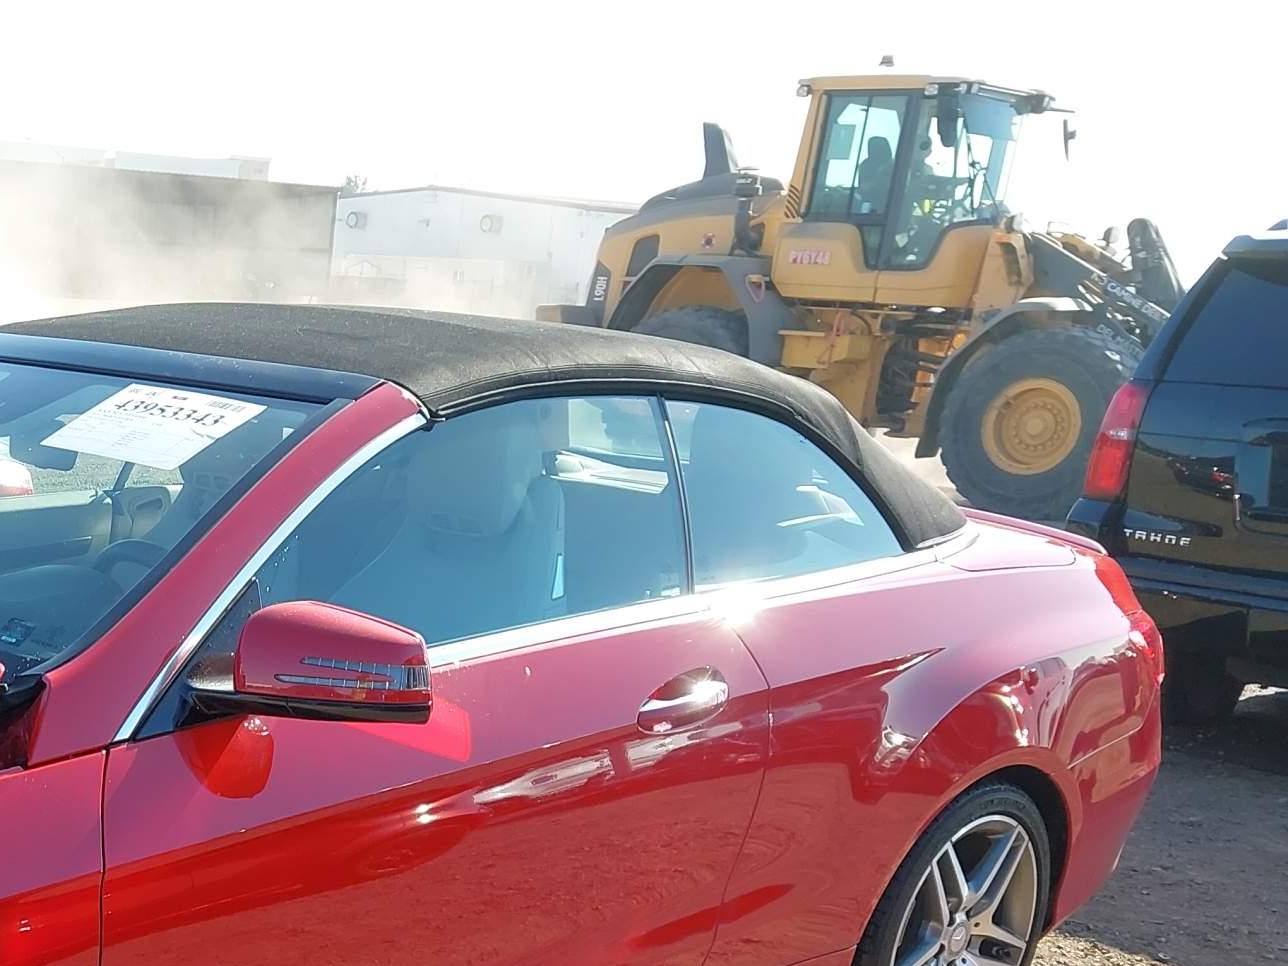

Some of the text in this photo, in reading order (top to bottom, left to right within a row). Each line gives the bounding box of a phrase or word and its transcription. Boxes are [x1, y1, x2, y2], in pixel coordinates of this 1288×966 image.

[592, 276, 609, 301] L90H
[114, 399, 226, 426] 43953343
[1123, 528, 1192, 547] TAHOE
